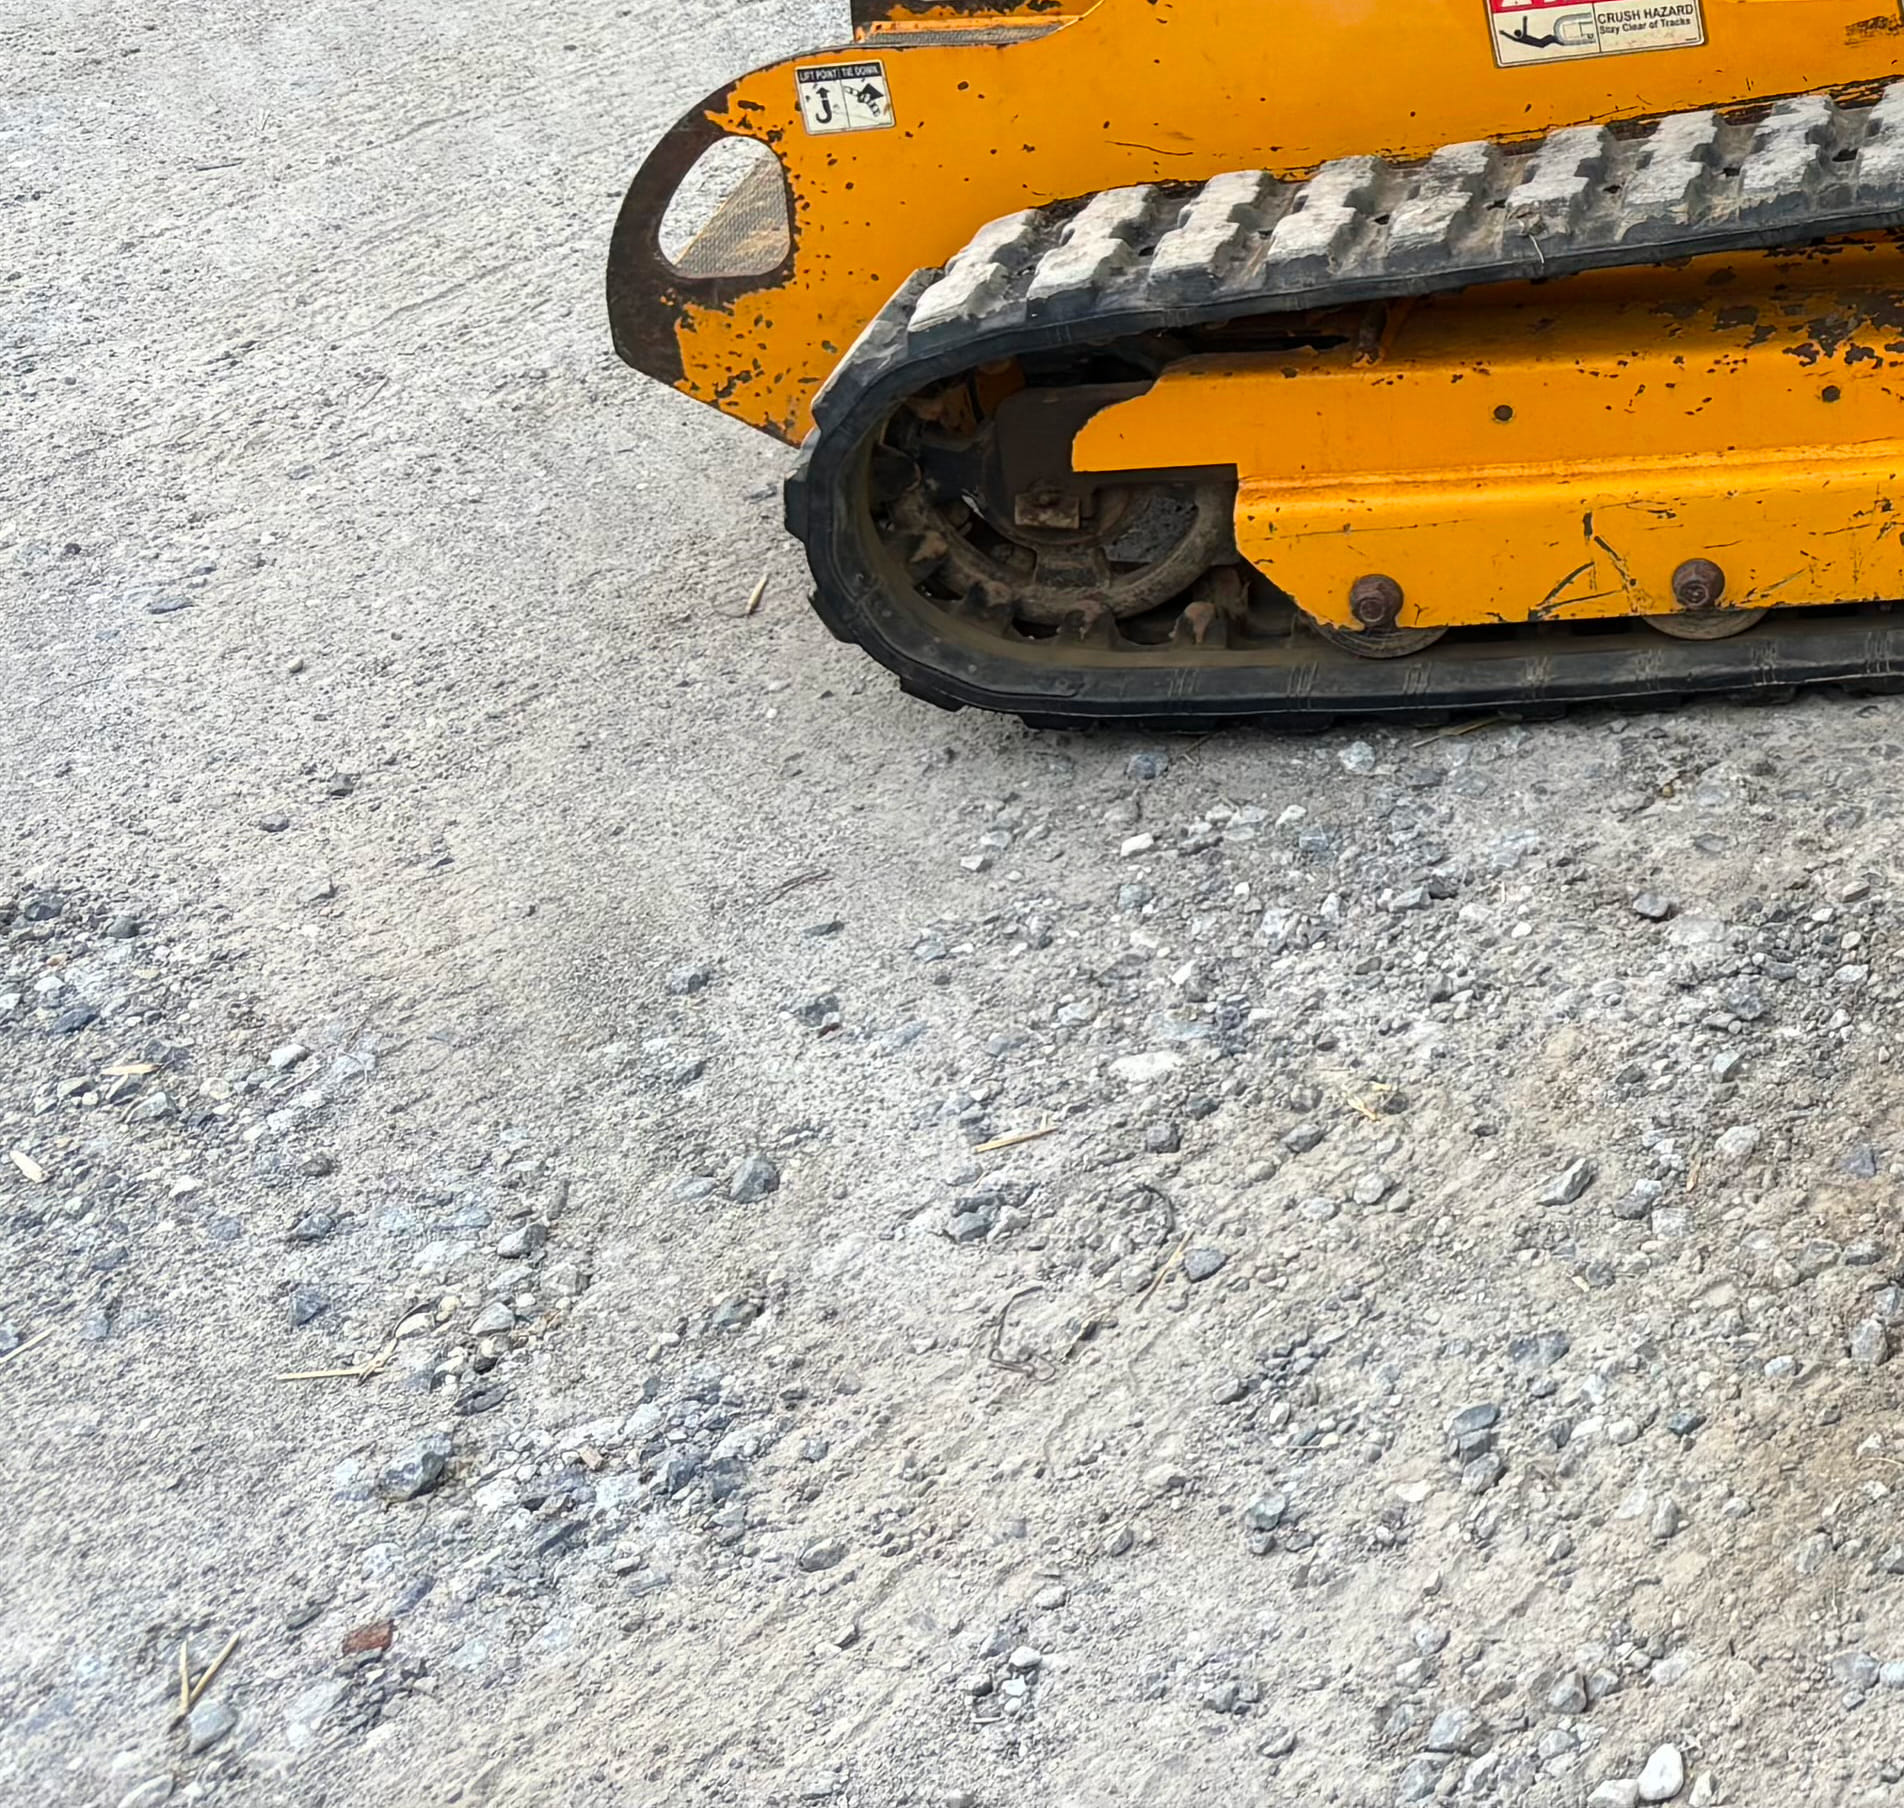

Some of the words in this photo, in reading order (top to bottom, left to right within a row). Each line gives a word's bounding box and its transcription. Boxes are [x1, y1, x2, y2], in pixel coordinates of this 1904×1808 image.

[1597, 9, 1641, 24] CRUSH
[1644, 4, 1693, 19] HAZARD
[1599, 24, 1620, 36] Stay
[1622, 21, 1647, 32] Clear
[1649, 19, 1658, 29] of
[1659, 18, 1691, 28] Tracks
